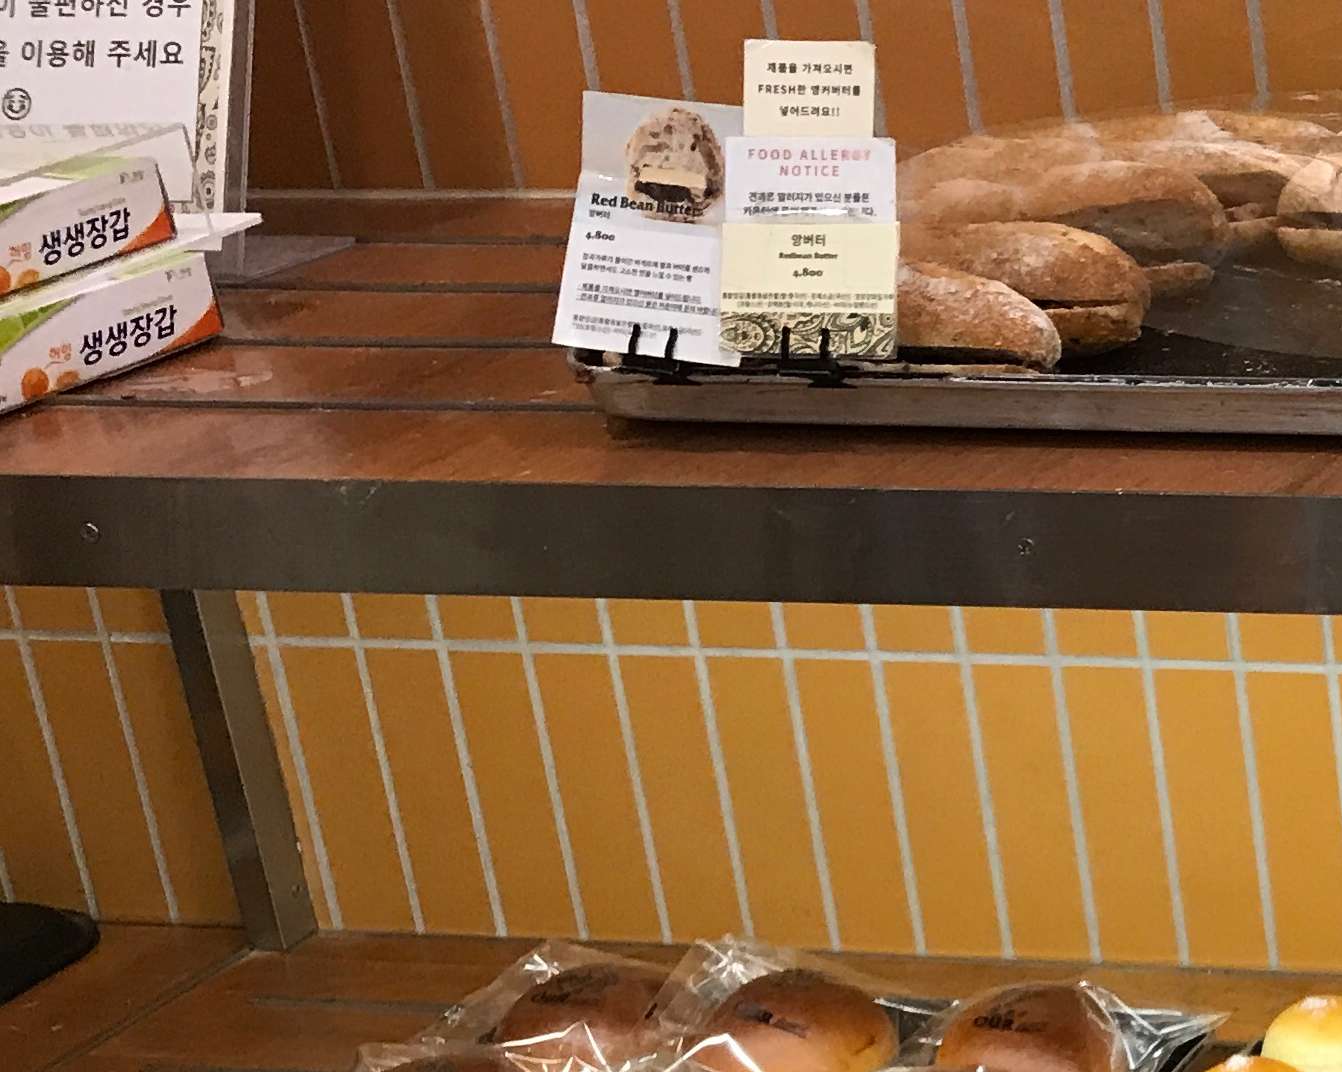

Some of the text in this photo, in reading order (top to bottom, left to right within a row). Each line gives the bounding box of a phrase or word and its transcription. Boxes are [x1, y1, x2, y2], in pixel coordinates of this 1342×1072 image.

[22, 40, 95, 68] 이용해
[108, 40, 183, 68] 주세요
[748, 149, 872, 161] FOOD ALLERGY
[779, 165, 841, 177] NOTICE
[591, 193, 618, 208] Red
[620, 198, 653, 212] Bean
[39, 207, 131, 265] 생생장갑
[791, 234, 826, 247] 앙버터
[80, 304, 177, 366] 생생장갑
